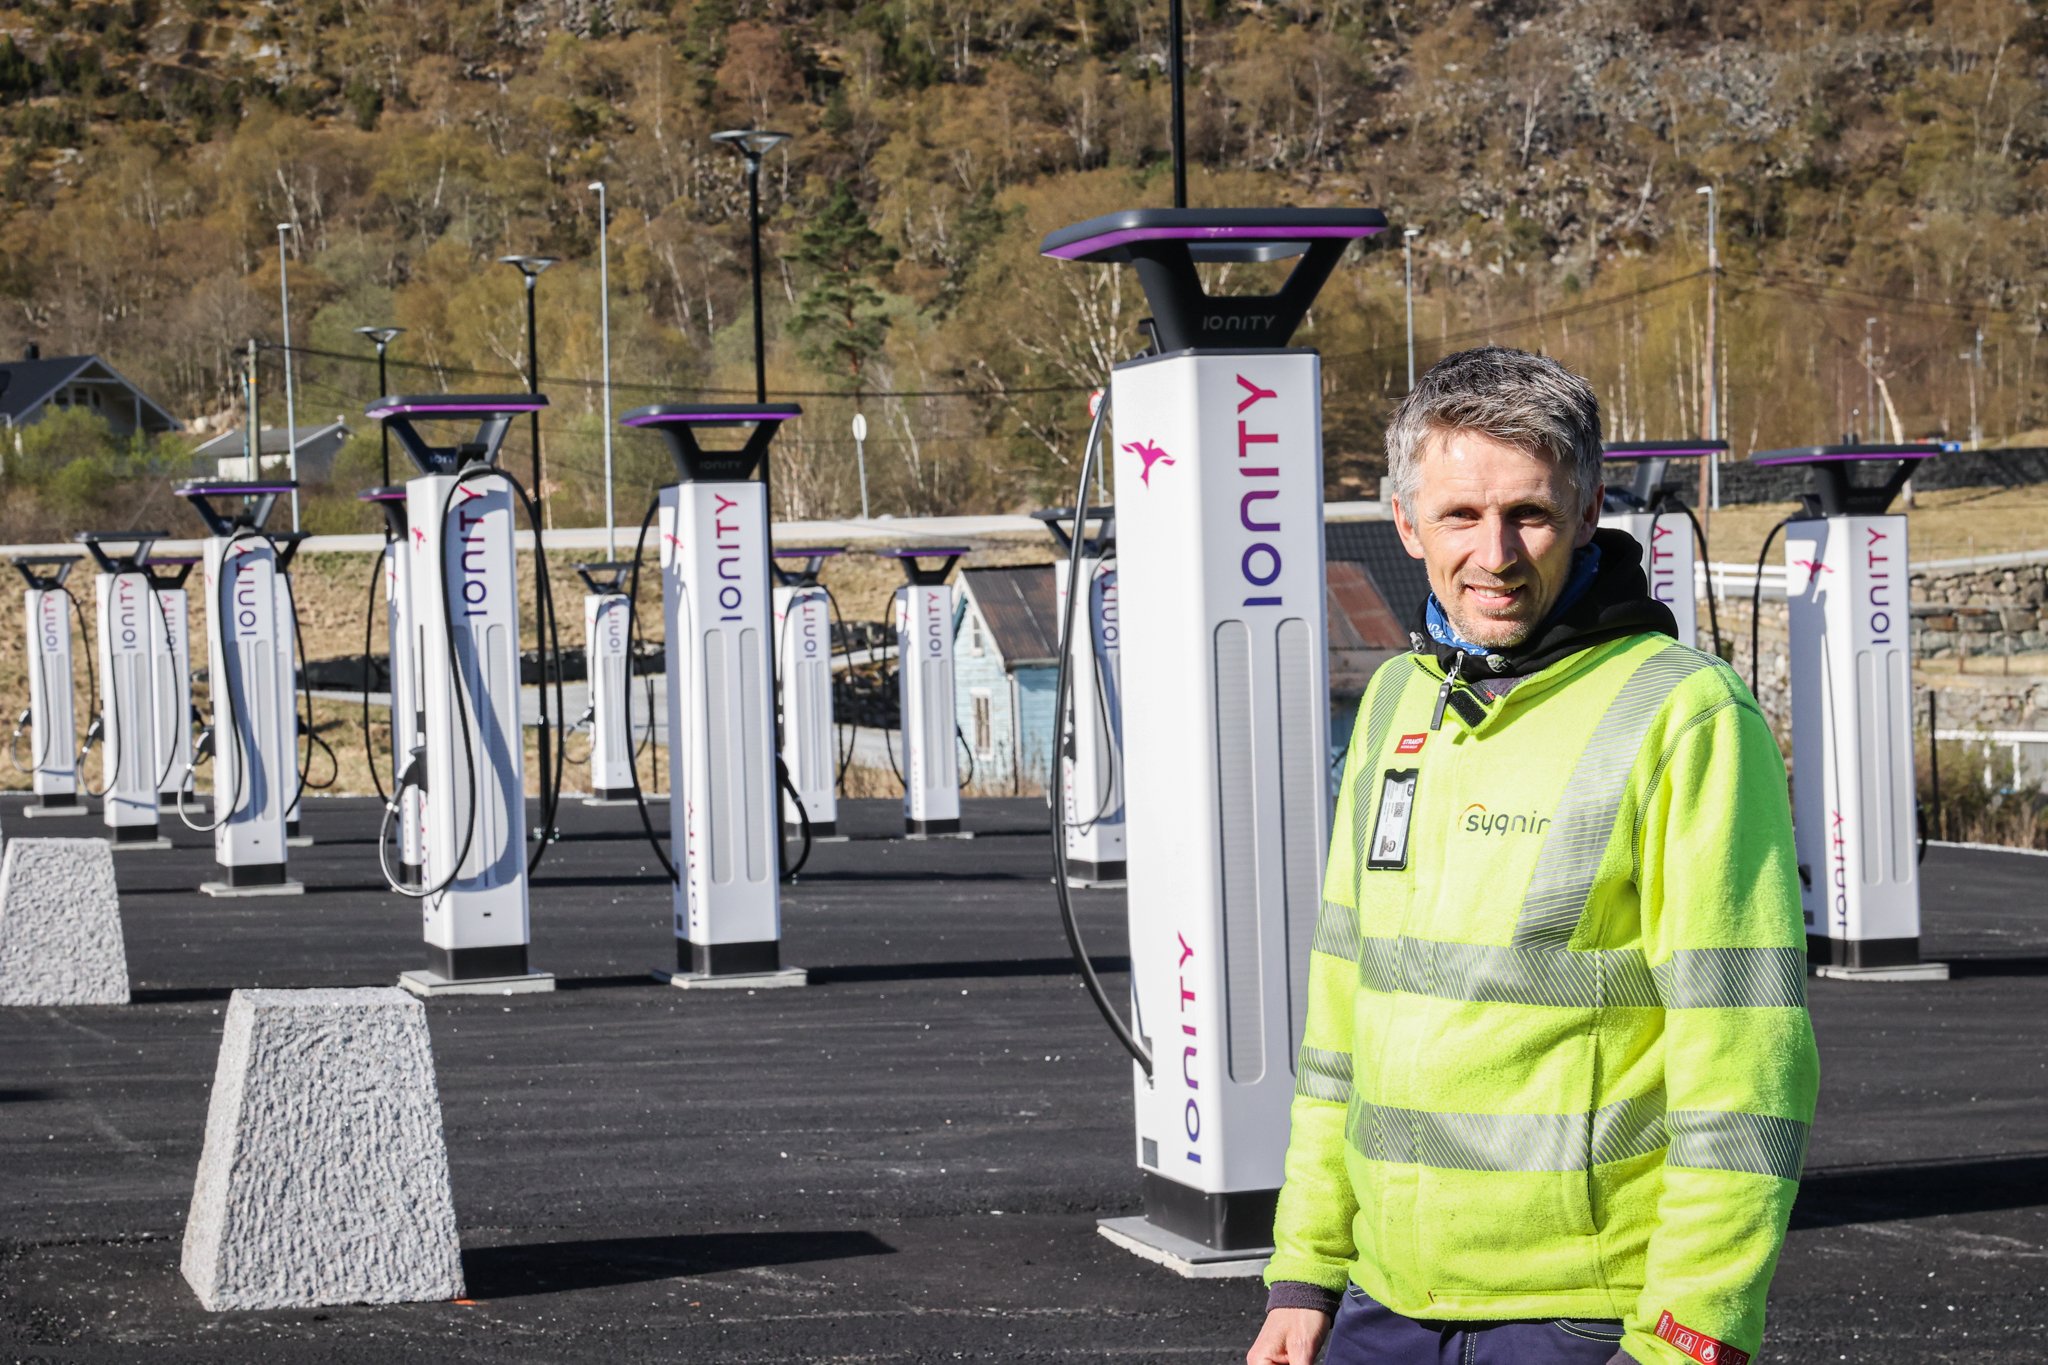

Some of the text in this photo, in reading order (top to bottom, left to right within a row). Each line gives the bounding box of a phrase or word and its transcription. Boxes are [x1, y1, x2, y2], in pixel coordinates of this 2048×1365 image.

[1202, 315, 1276, 330] IONITY
[1236, 373, 1283, 607] IONITY
[235, 544, 257, 635] IONITY
[458, 484, 488, 616] IONITY
[715, 493, 743, 621] IONITY
[1652, 524, 1675, 603] NITY
[1867, 527, 1891, 644] IONITY
[43, 593, 58, 652] IONITY
[119, 578, 137, 650] IONITY
[802, 593, 817, 659] IONITY
[927, 592, 943, 658] IONITY
[1100, 564, 1119, 650] IONITY
[1465, 810, 1552, 836] sygnir
[1833, 809, 1848, 927] IONITY
[1177, 930, 1203, 1165] IONITY
